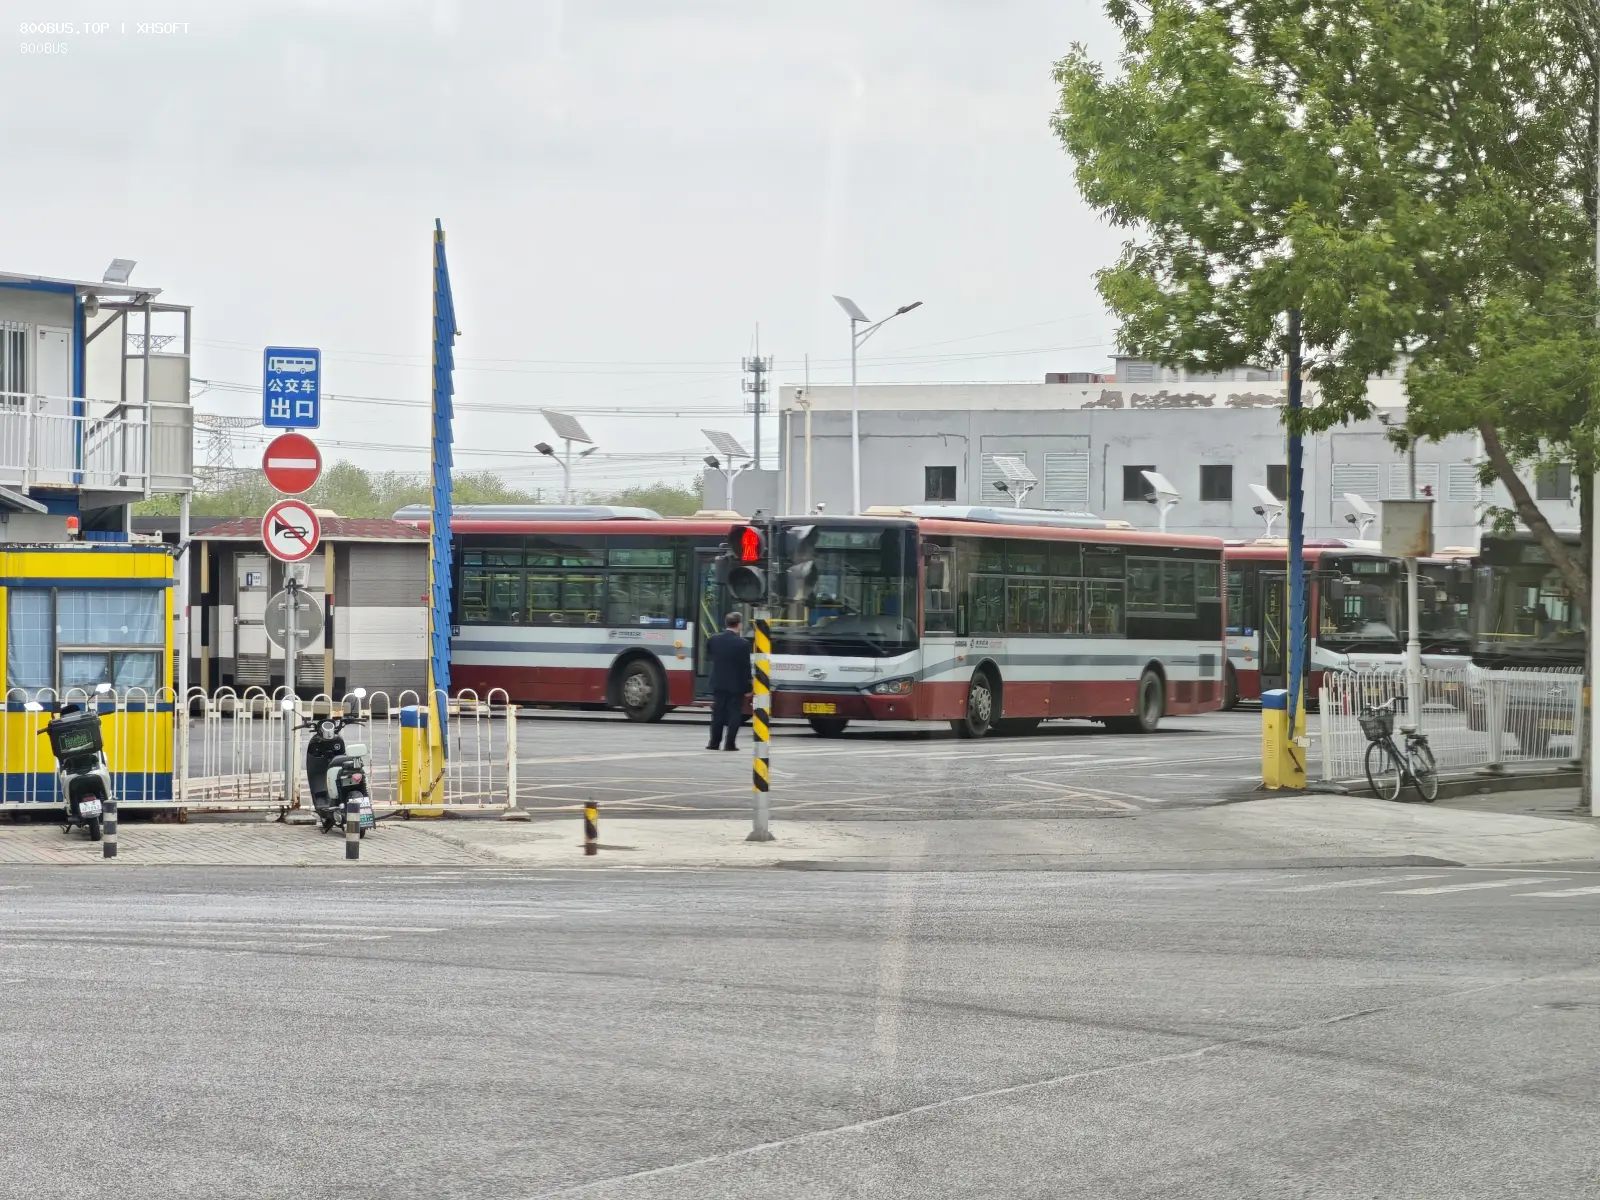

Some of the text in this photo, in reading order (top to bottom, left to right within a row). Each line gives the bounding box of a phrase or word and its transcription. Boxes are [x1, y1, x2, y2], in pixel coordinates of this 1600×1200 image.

[268, 378, 316, 394] 公交车
[270, 397, 314, 418] 出口
